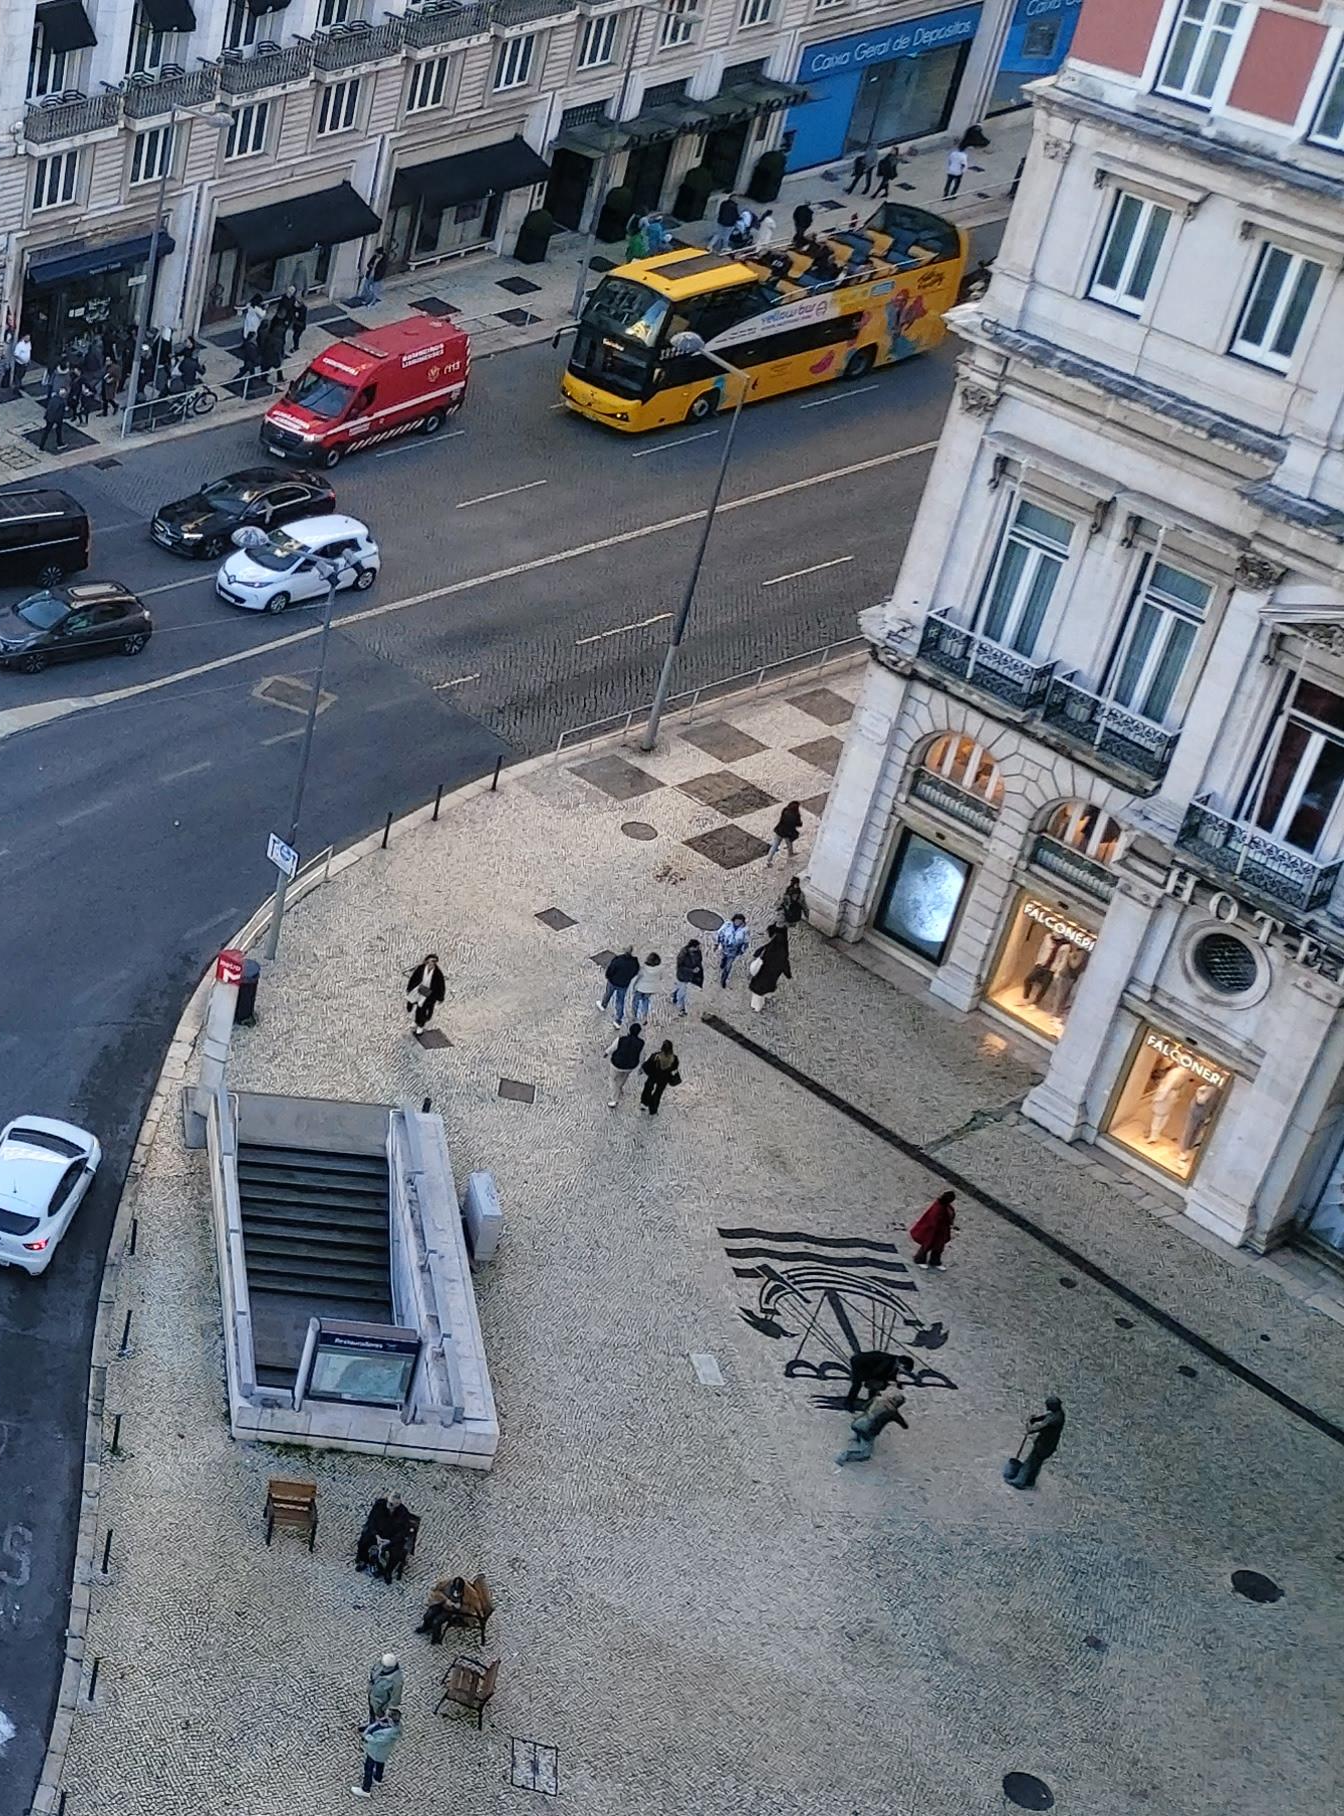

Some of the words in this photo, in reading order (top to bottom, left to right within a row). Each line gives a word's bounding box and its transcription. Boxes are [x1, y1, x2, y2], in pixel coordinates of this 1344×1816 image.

[812, 53, 850, 73] Caixa
[854, 40, 891, 61] Geral
[892, 35, 909, 51] de
[1023, 903, 1096, 951] FALCONERI
[1146, 1034, 1226, 1088] FALCONERI
